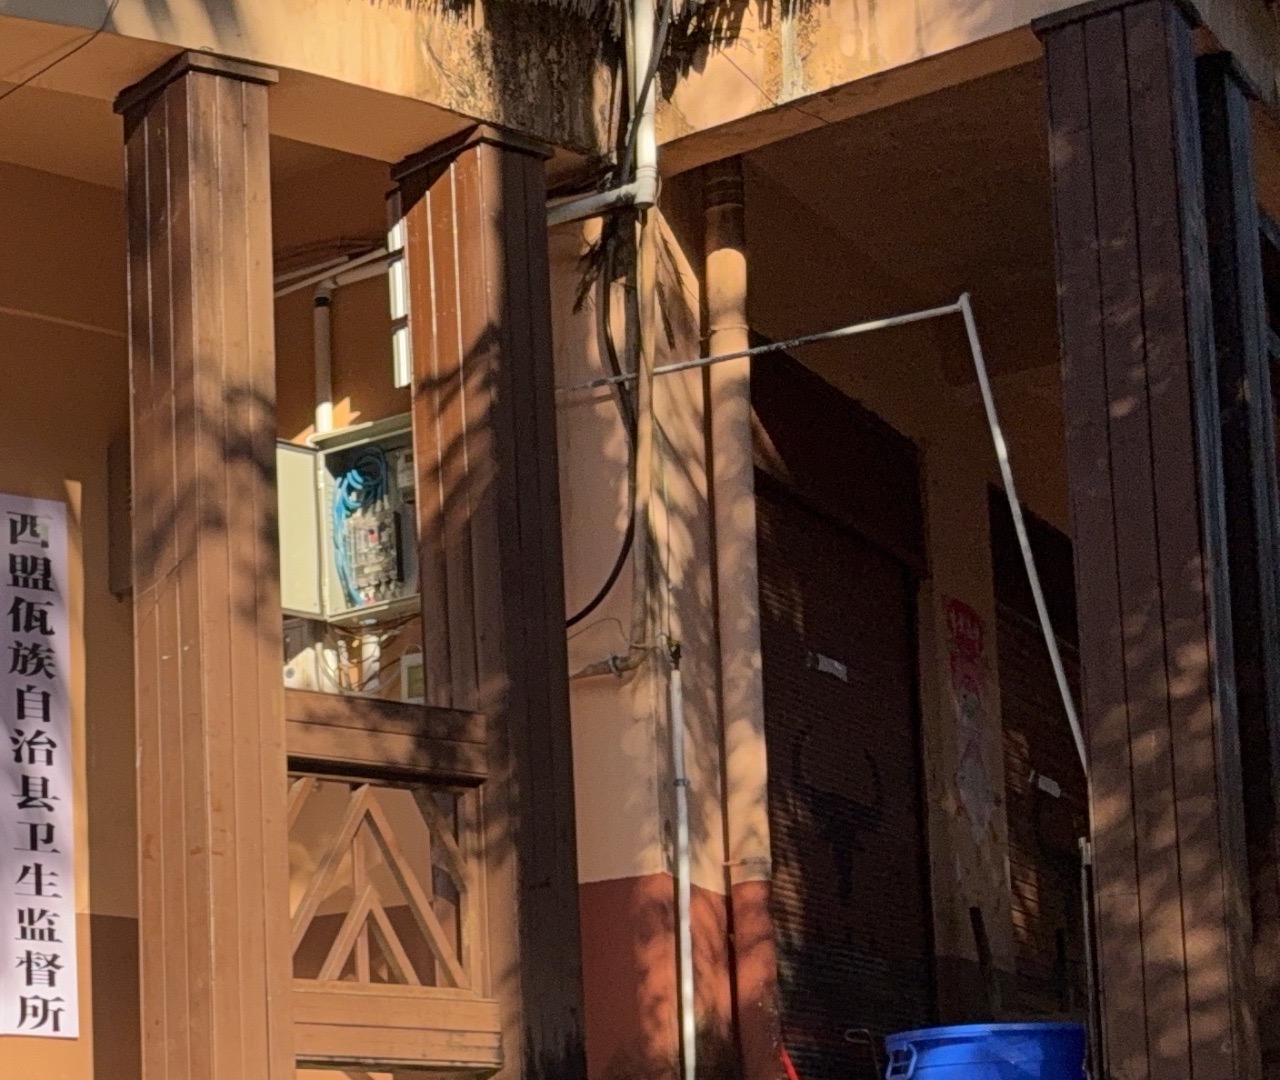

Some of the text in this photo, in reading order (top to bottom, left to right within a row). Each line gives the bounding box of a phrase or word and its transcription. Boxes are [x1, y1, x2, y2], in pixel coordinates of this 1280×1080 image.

[6, 511, 65, 1033] 西盟佤族自治县卫生监督所
